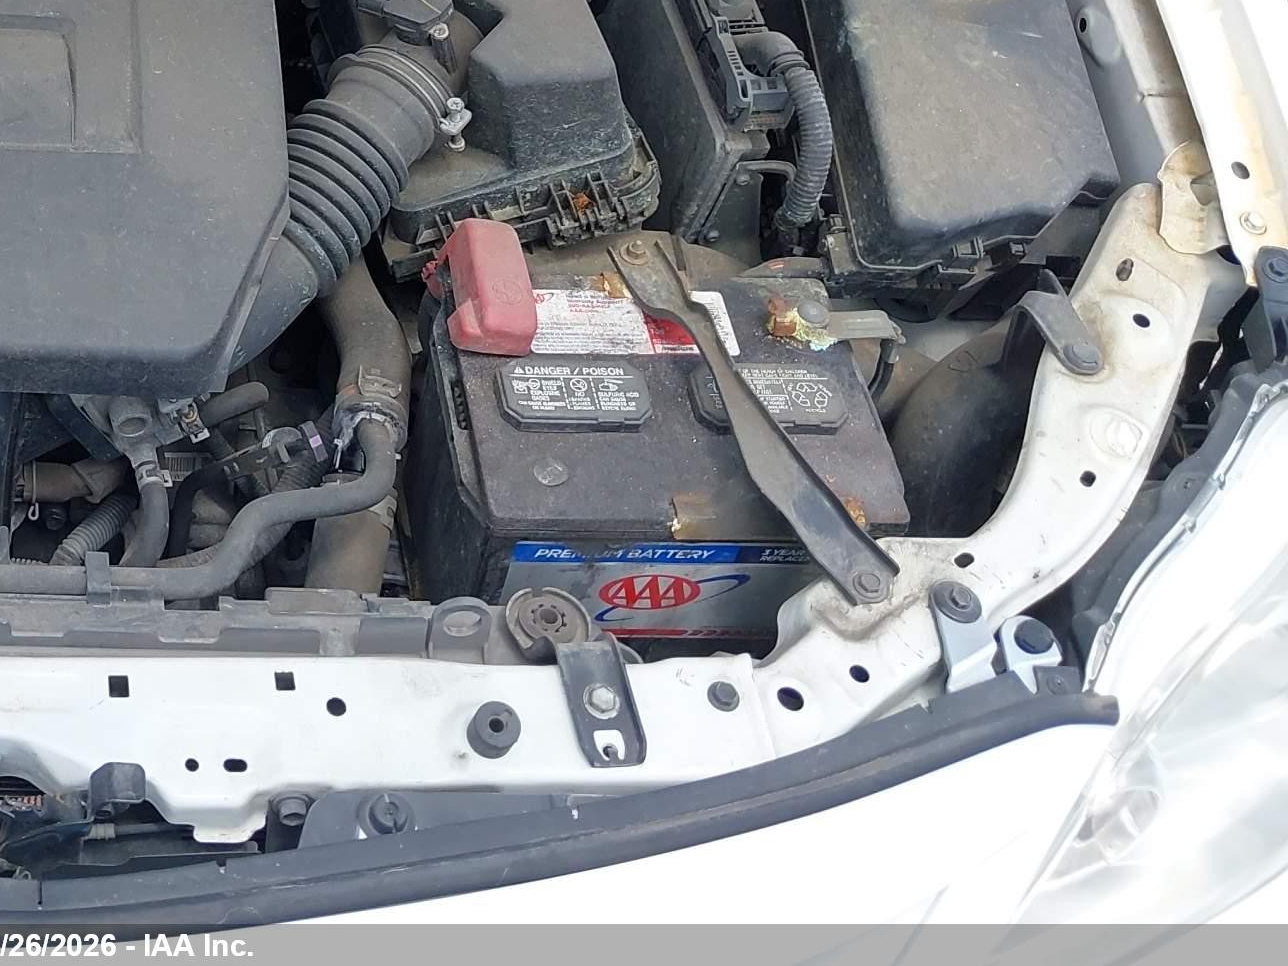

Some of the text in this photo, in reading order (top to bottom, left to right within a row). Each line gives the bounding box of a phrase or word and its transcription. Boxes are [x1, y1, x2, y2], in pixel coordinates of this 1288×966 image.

[524, 366, 571, 375] DANGER
[582, 367, 624, 376] POISON
[626, 548, 714, 560] BATTERY
[609, 574, 693, 610] AAA
